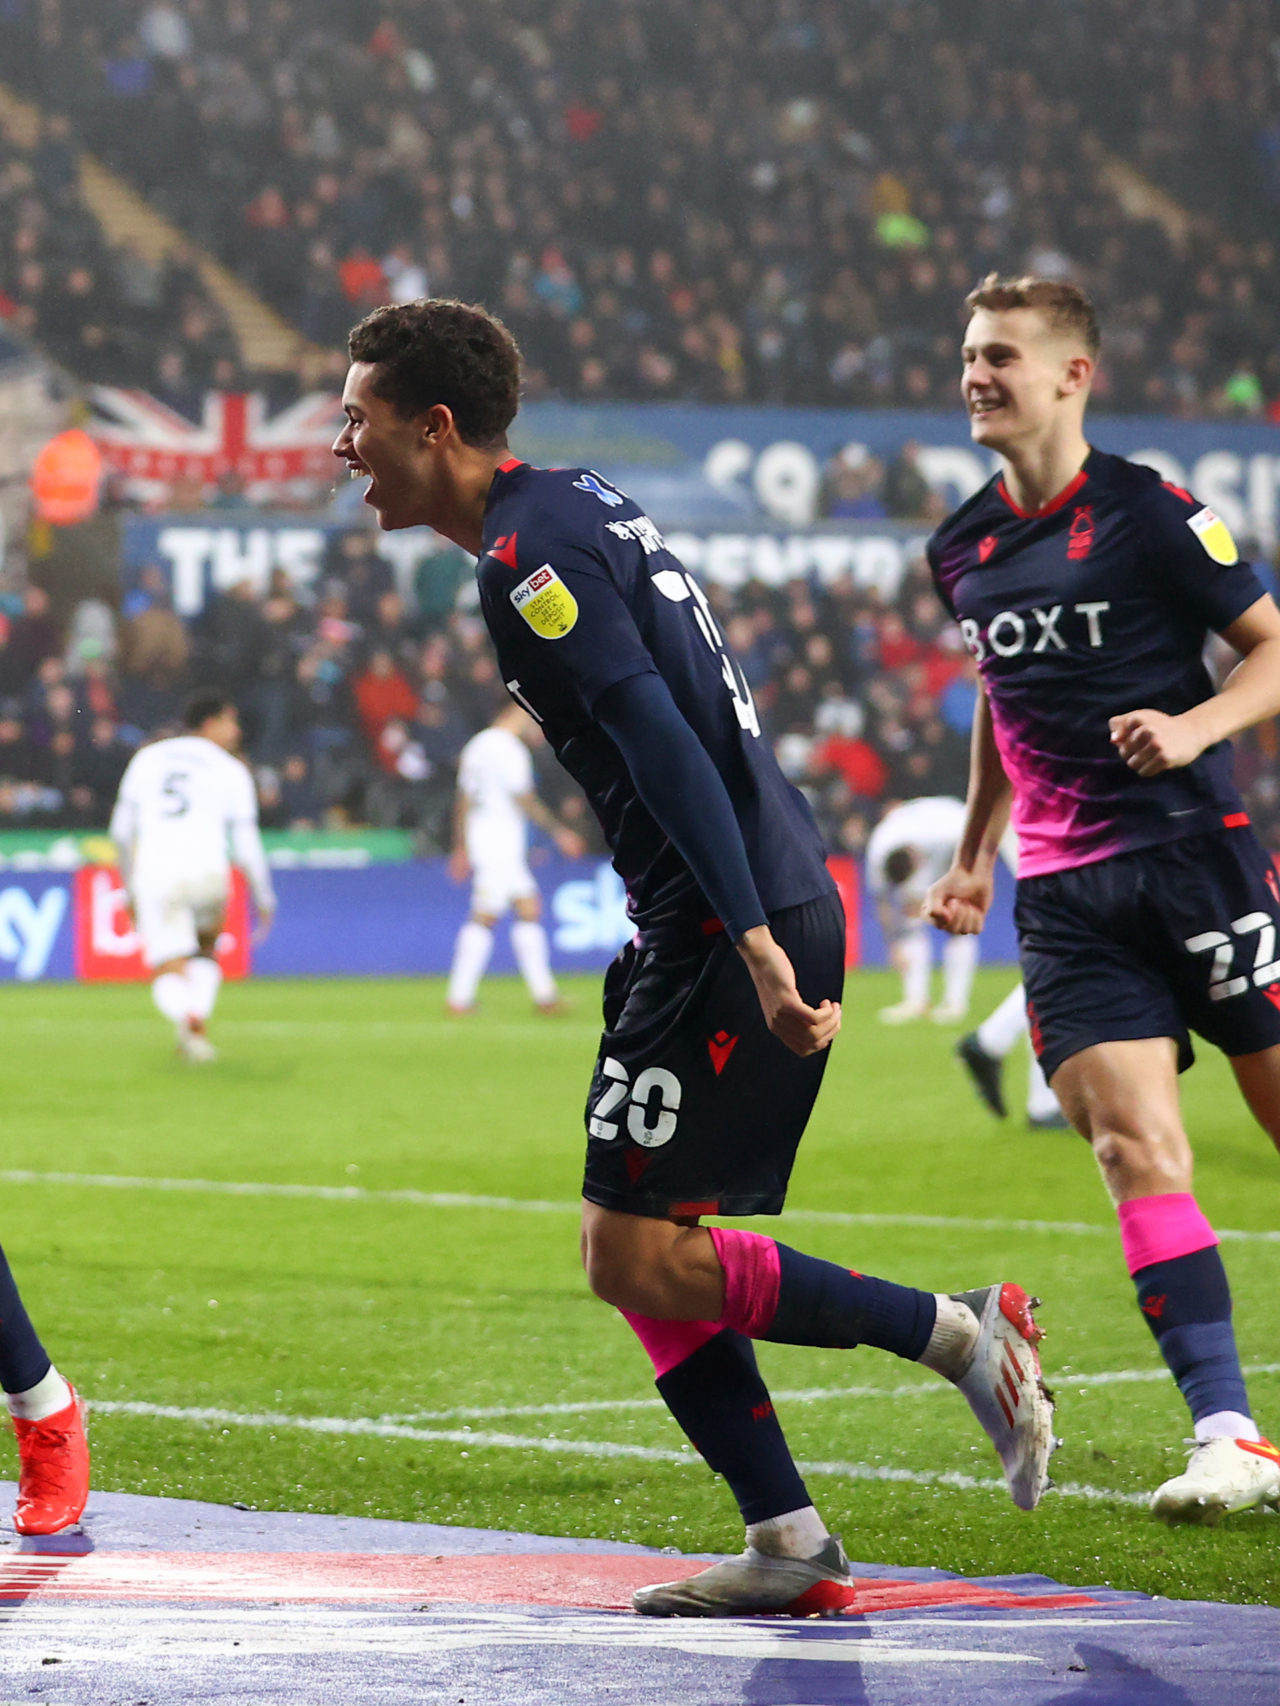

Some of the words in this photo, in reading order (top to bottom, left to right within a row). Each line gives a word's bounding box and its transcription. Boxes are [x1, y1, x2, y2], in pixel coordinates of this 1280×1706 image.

[515, 587, 531, 604] sky
[530, 571, 550, 589] bet
[530, 596, 545, 609] STAY
[960, 601, 1111, 662] BOXT
[163, 771, 190, 819] 5
[552, 861, 639, 950] sk
[1184, 911, 1280, 1001] 22
[589, 1056, 682, 1148] 20
